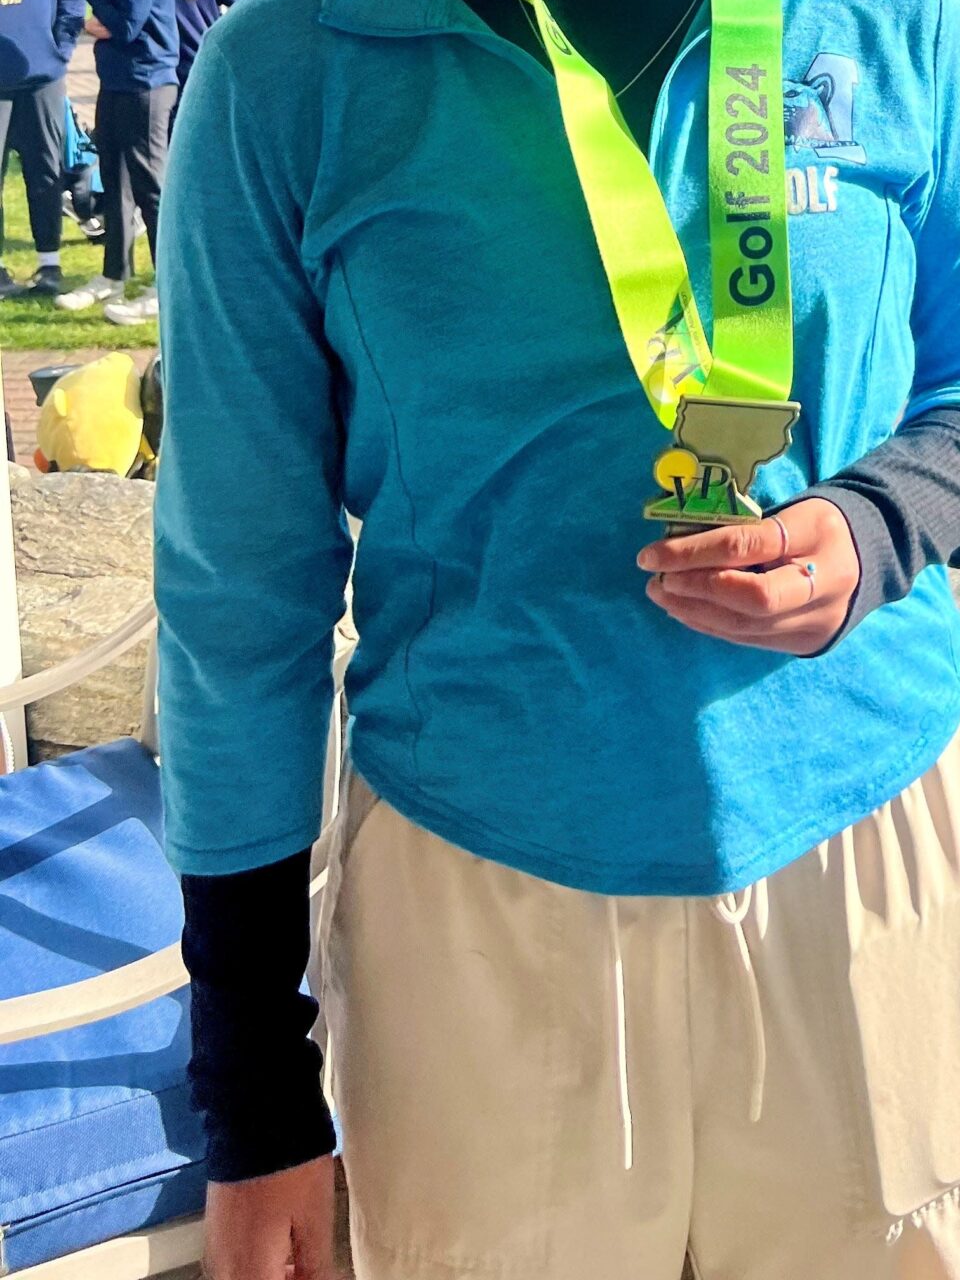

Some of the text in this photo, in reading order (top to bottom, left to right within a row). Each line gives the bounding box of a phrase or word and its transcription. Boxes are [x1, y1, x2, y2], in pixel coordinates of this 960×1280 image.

[725, 63, 775, 307] Golf 2024
[785, 166, 839, 216] OLF
